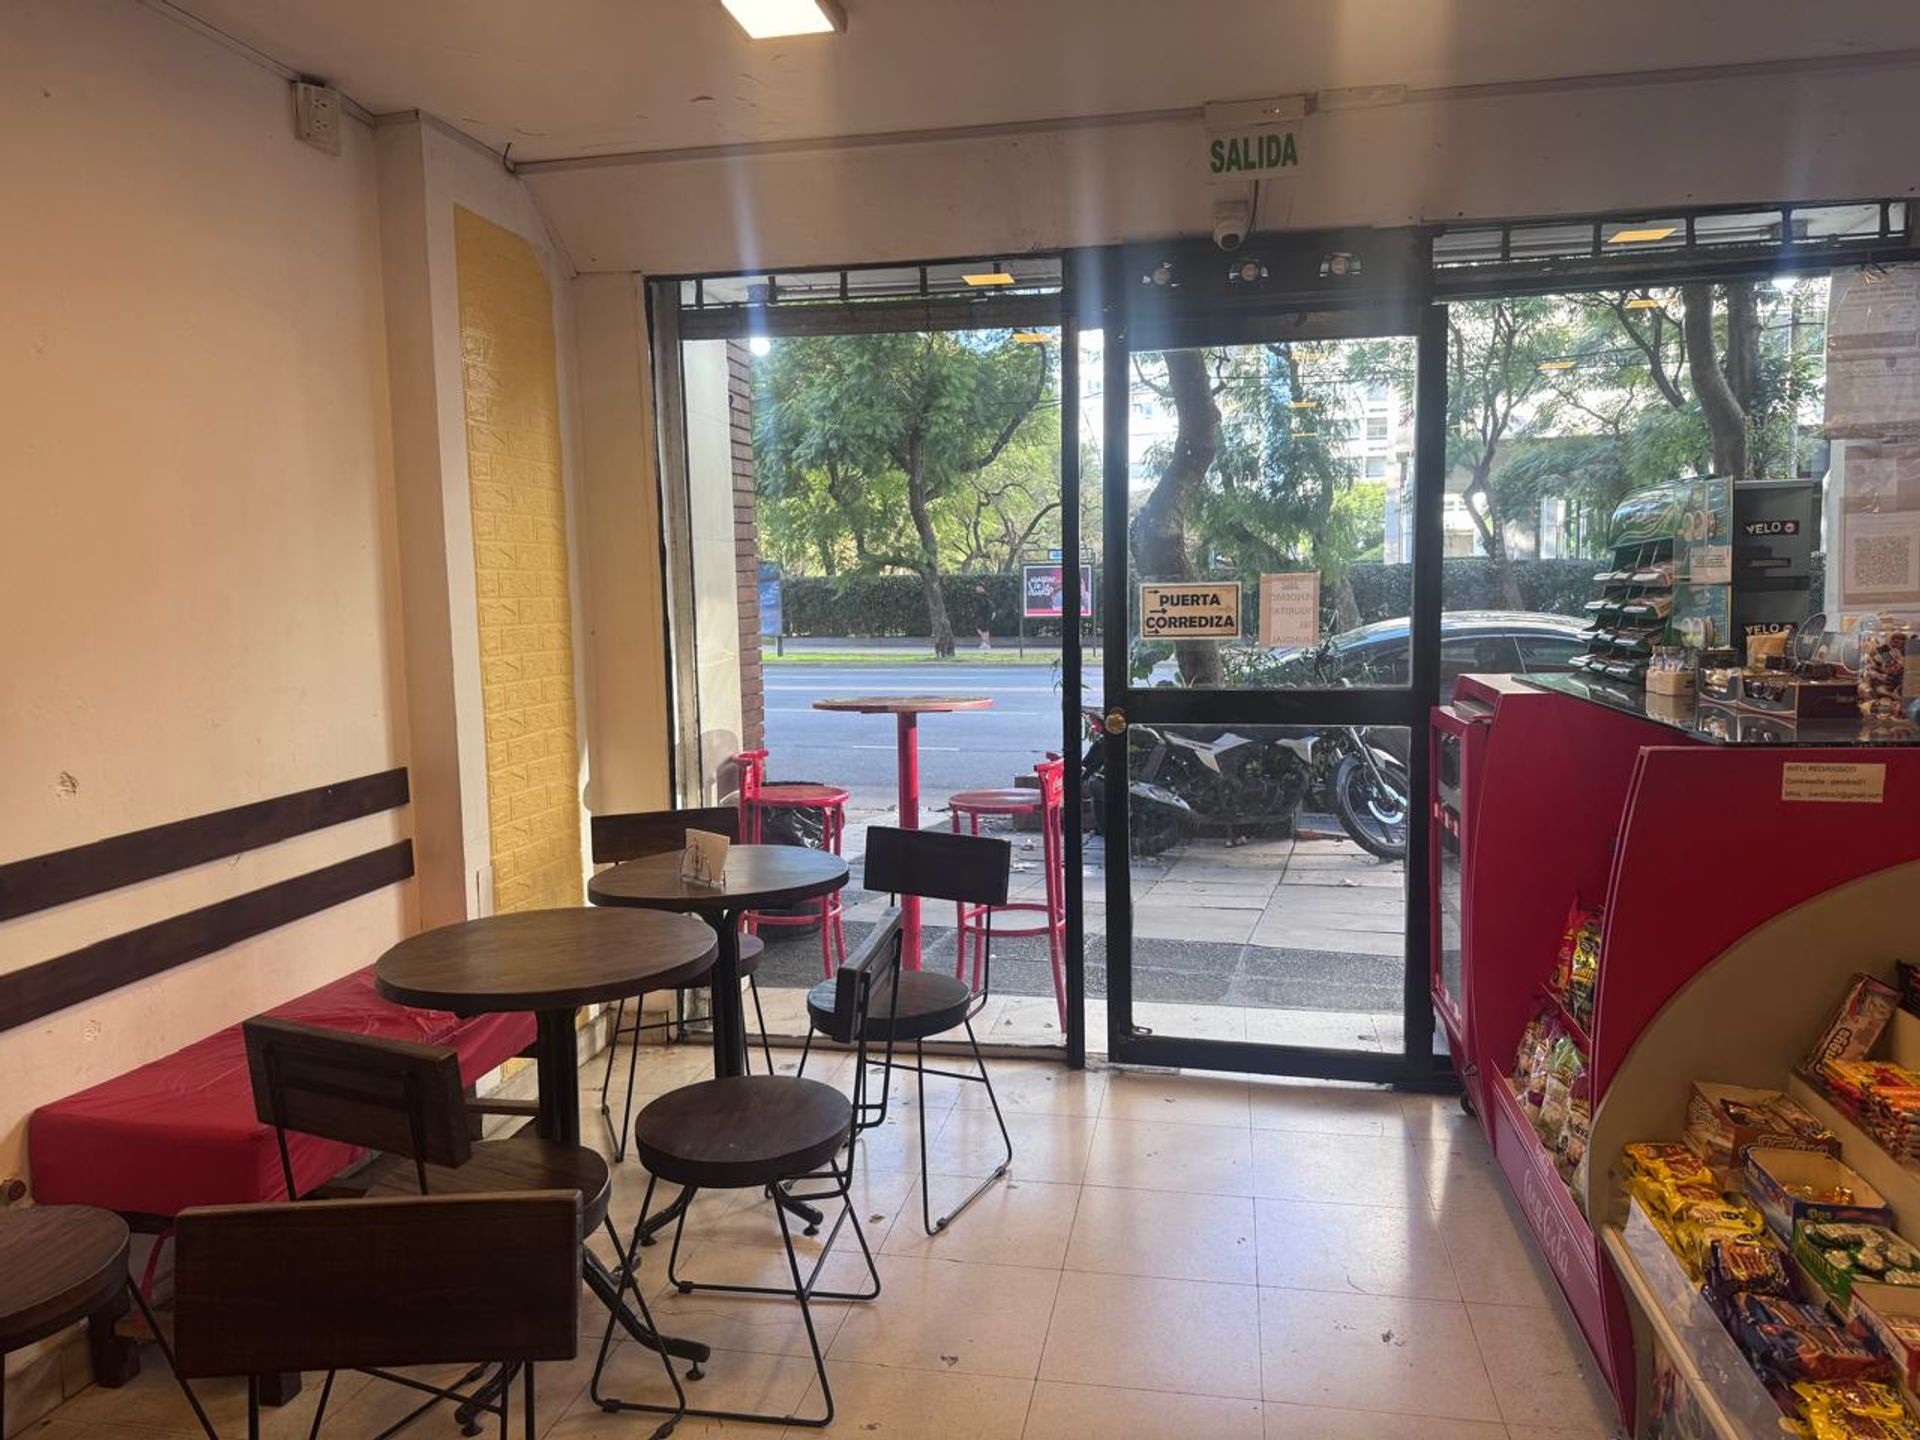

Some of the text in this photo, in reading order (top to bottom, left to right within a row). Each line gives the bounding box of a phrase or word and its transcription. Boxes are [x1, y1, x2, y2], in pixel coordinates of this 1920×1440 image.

[1210, 132, 1298, 173] SALIDA
[1746, 522, 1781, 534] VELO
[1159, 594, 1221, 606] PUERTA
[1146, 615, 1234, 628] CORREDIZA
[1744, 624, 1779, 635] VELO
